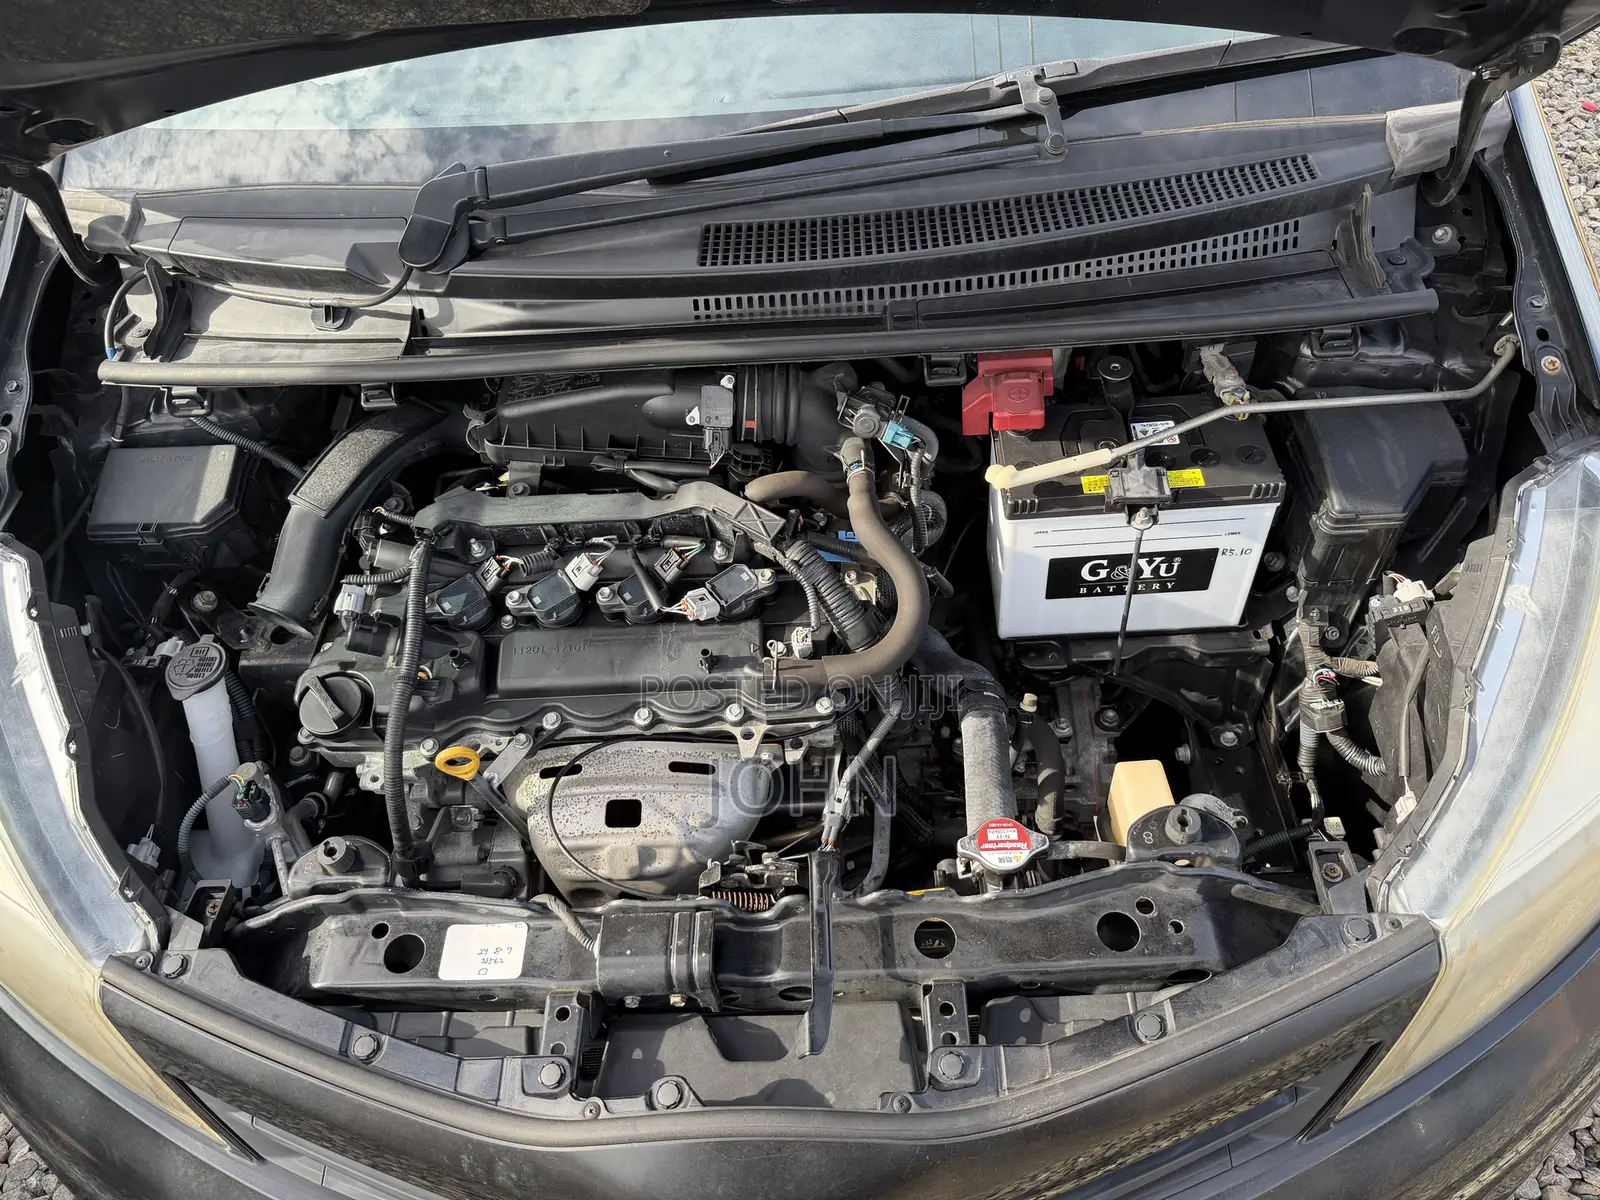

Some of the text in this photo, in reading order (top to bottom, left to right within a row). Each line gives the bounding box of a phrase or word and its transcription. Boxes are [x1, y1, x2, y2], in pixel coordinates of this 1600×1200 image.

[1220, 547, 1253, 557] R5.10
[1079, 581, 1176, 594] BATTERY
[980, 841, 1029, 850] Roadpartner
